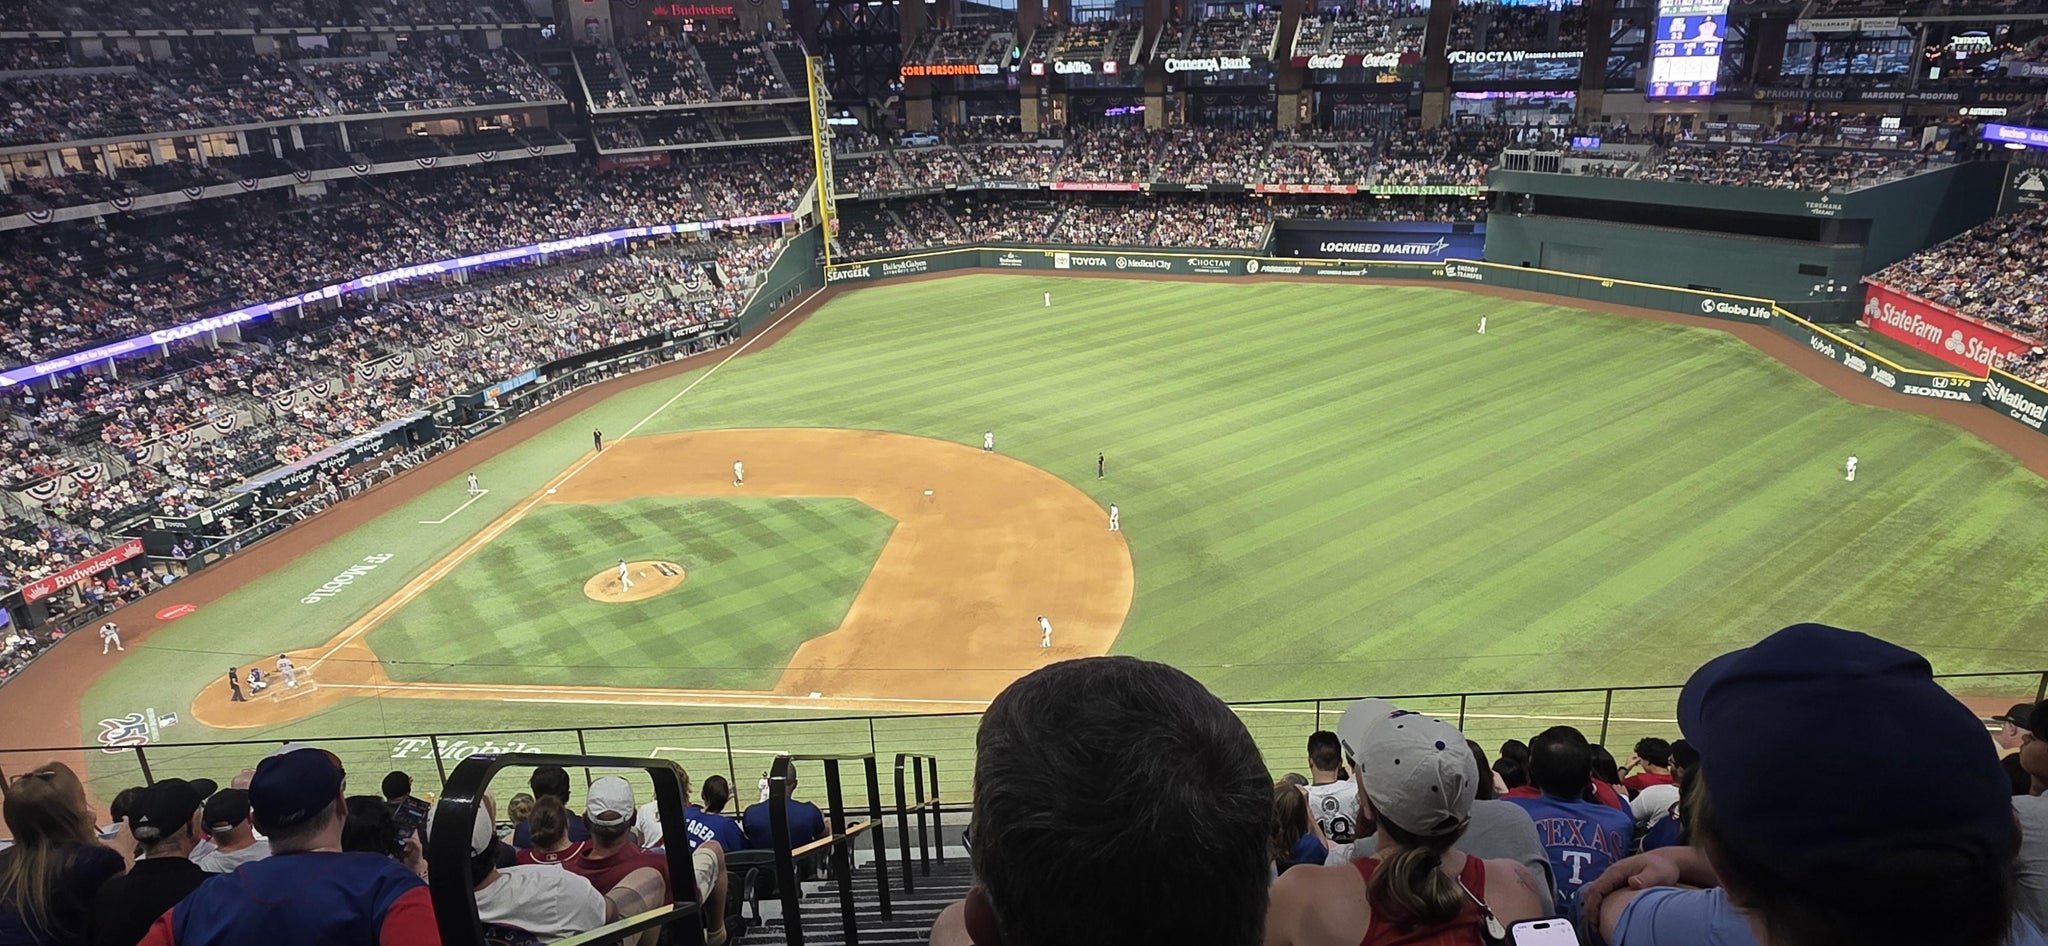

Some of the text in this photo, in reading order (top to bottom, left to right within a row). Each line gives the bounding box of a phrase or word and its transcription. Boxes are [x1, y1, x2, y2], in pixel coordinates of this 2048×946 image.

[671, 4, 734, 16] Budweiser
[1220, 55, 1251, 70] Bank
[1455, 50, 1526, 63] CHOCTAW
[901, 65, 925, 76] CORE
[926, 64, 979, 76] PERSONNEL
[1765, 89, 1844, 99] PRIORITY GOLD
[1861, 91, 1959, 101] HARGROVE ROOFING
[1379, 185, 1477, 196] LUXOR STAFFING
[1320, 242, 1431, 255] LOCKHEED MARTIN
[1071, 257, 1108, 267] TOYOTA
[1128, 259, 1172, 270] Medical City
[1190, 258, 1231, 267] CHOCTAW
[827, 267, 870, 282] SEATGEEK
[1716, 301, 1749, 317] Globe
[1749, 306, 1771, 320] Life
[1810, 335, 1836, 359] Kubota
[1949, 377, 1971, 388] 374
[1903, 384, 1972, 403] HONDA
[2010, 408, 2042, 429] Car Rental
[364, 437, 384, 452] Kroger
[329, 453, 350, 467] Kroger
[291, 468, 314, 484] Kroger
[213, 501, 240, 516] TOYOTA
[54, 554, 119, 588] Budweiser
[300, 564, 378, 604] Mobile
[686, 819, 715, 841] AGER
[1562, 850, 1592, 885] T
